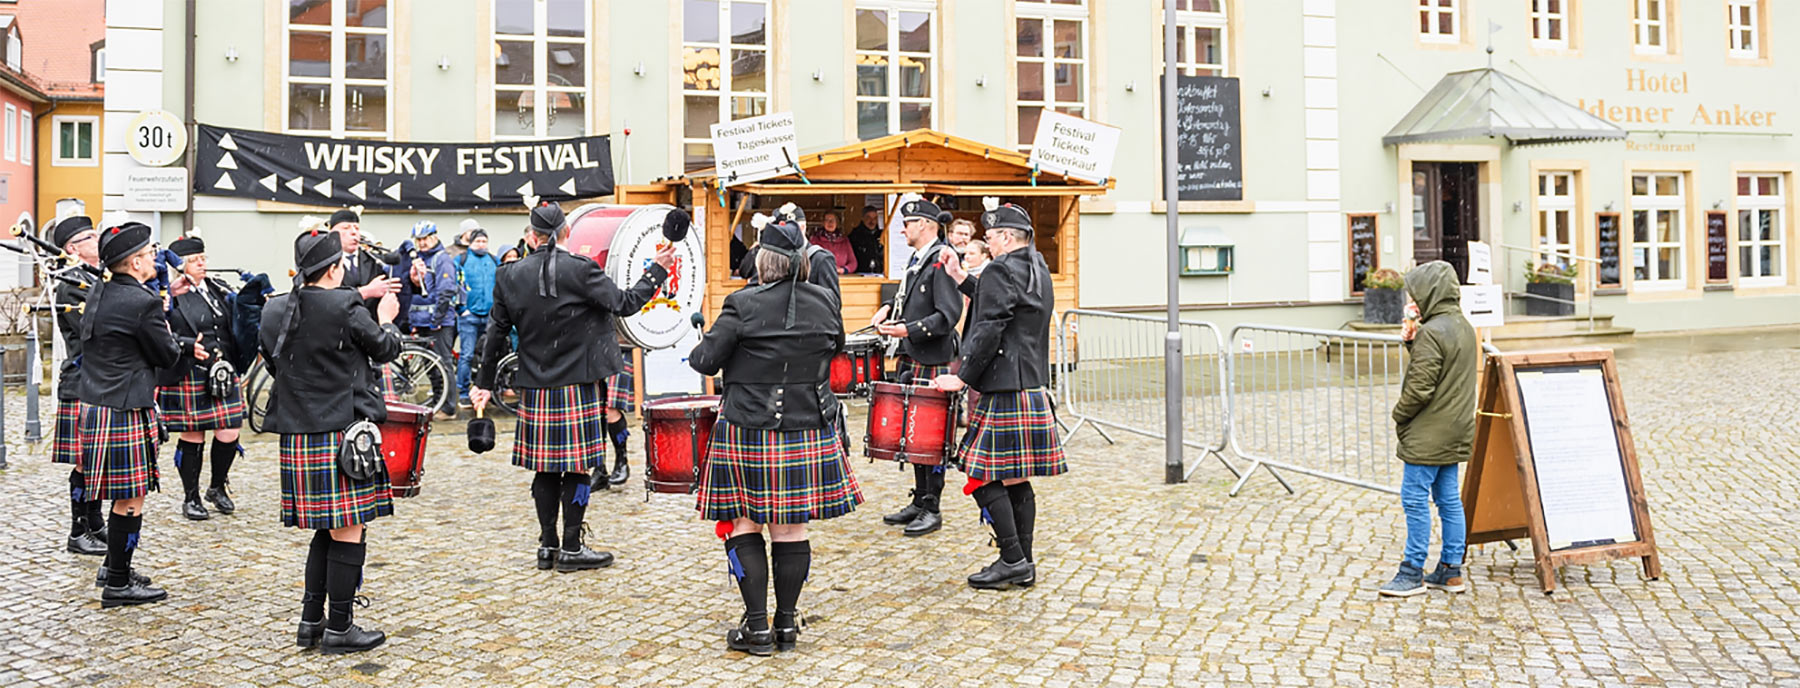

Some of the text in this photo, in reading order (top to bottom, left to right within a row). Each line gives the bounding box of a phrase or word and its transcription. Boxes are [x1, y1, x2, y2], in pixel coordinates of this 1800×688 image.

[1625, 68, 1689, 94] Hotel
[1579, 98, 1777, 127] ldener Anker
[139, 126, 172, 148] 30 t
[716, 118, 793, 138] Festival Tickets
[1053, 122, 1096, 142] Festival
[737, 133, 794, 150] Tageskasse
[1052, 137, 1090, 155] Tickets
[1625, 140, 1696, 152] Restaurant
[304, 141, 600, 175] WHISKY FESTIVAL
[721, 153, 770, 169] Seminare
[1037, 148, 1097, 172] Vorverkauf
[128, 174, 184, 183] Feuerwehrzufahrt
[907, 404, 918, 444] AXIAL
